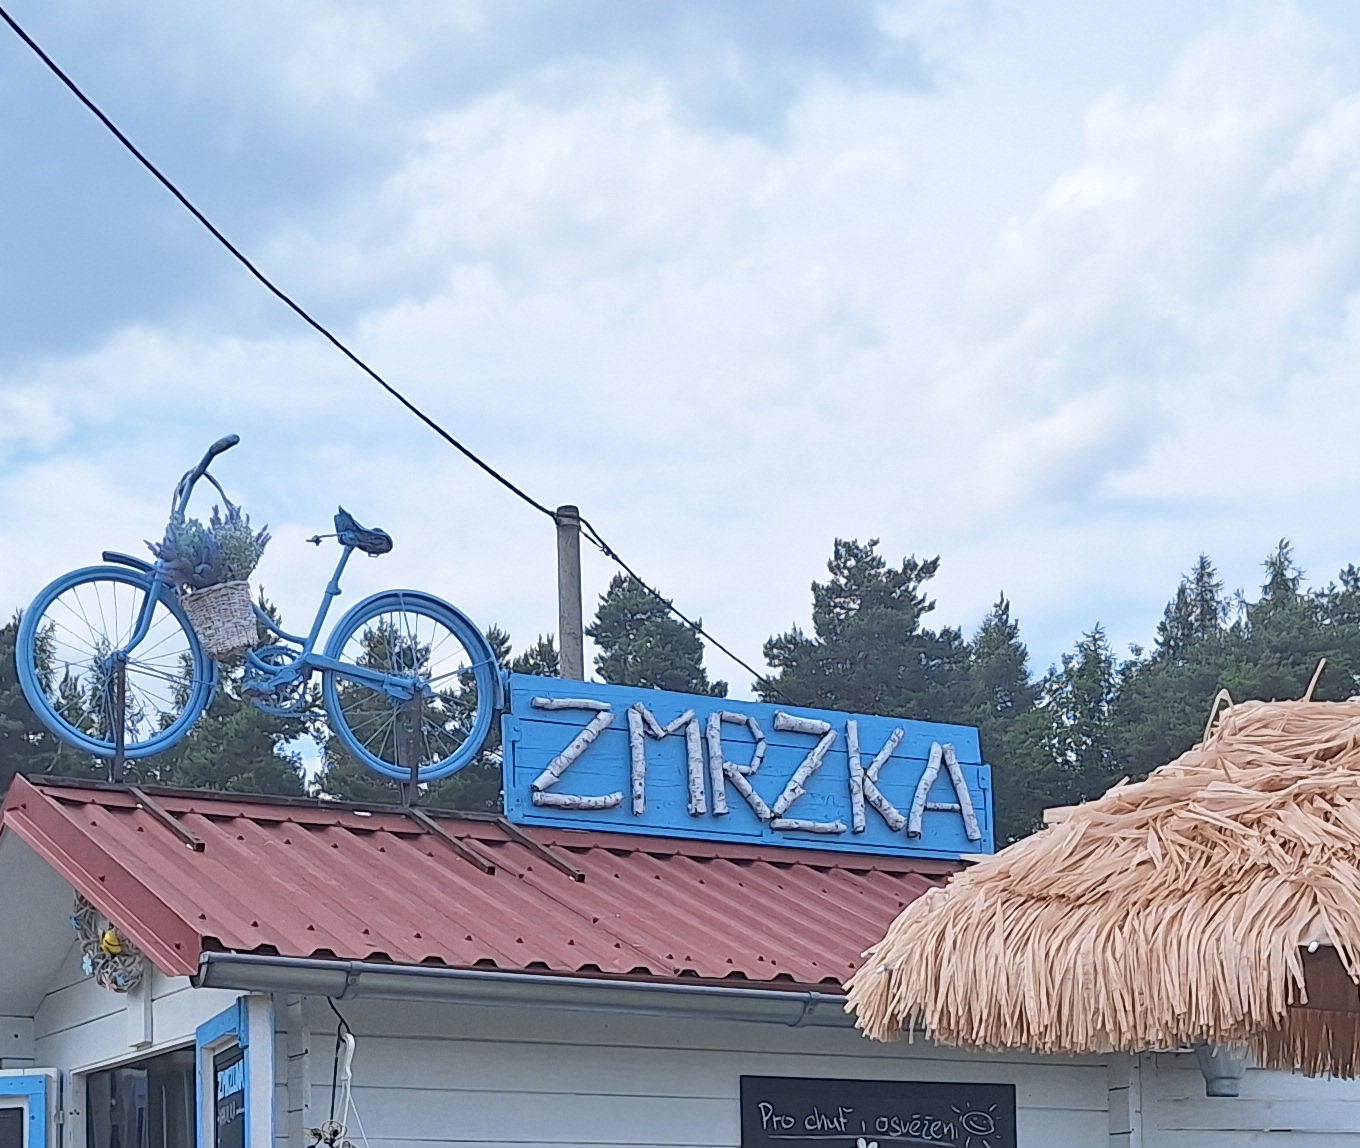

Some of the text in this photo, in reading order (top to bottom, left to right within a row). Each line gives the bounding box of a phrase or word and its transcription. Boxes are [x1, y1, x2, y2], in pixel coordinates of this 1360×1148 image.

[531, 696, 981, 842] ZMRZKA
[758, 1102, 795, 1131] Pro
[804, 1106, 854, 1132] chuť
